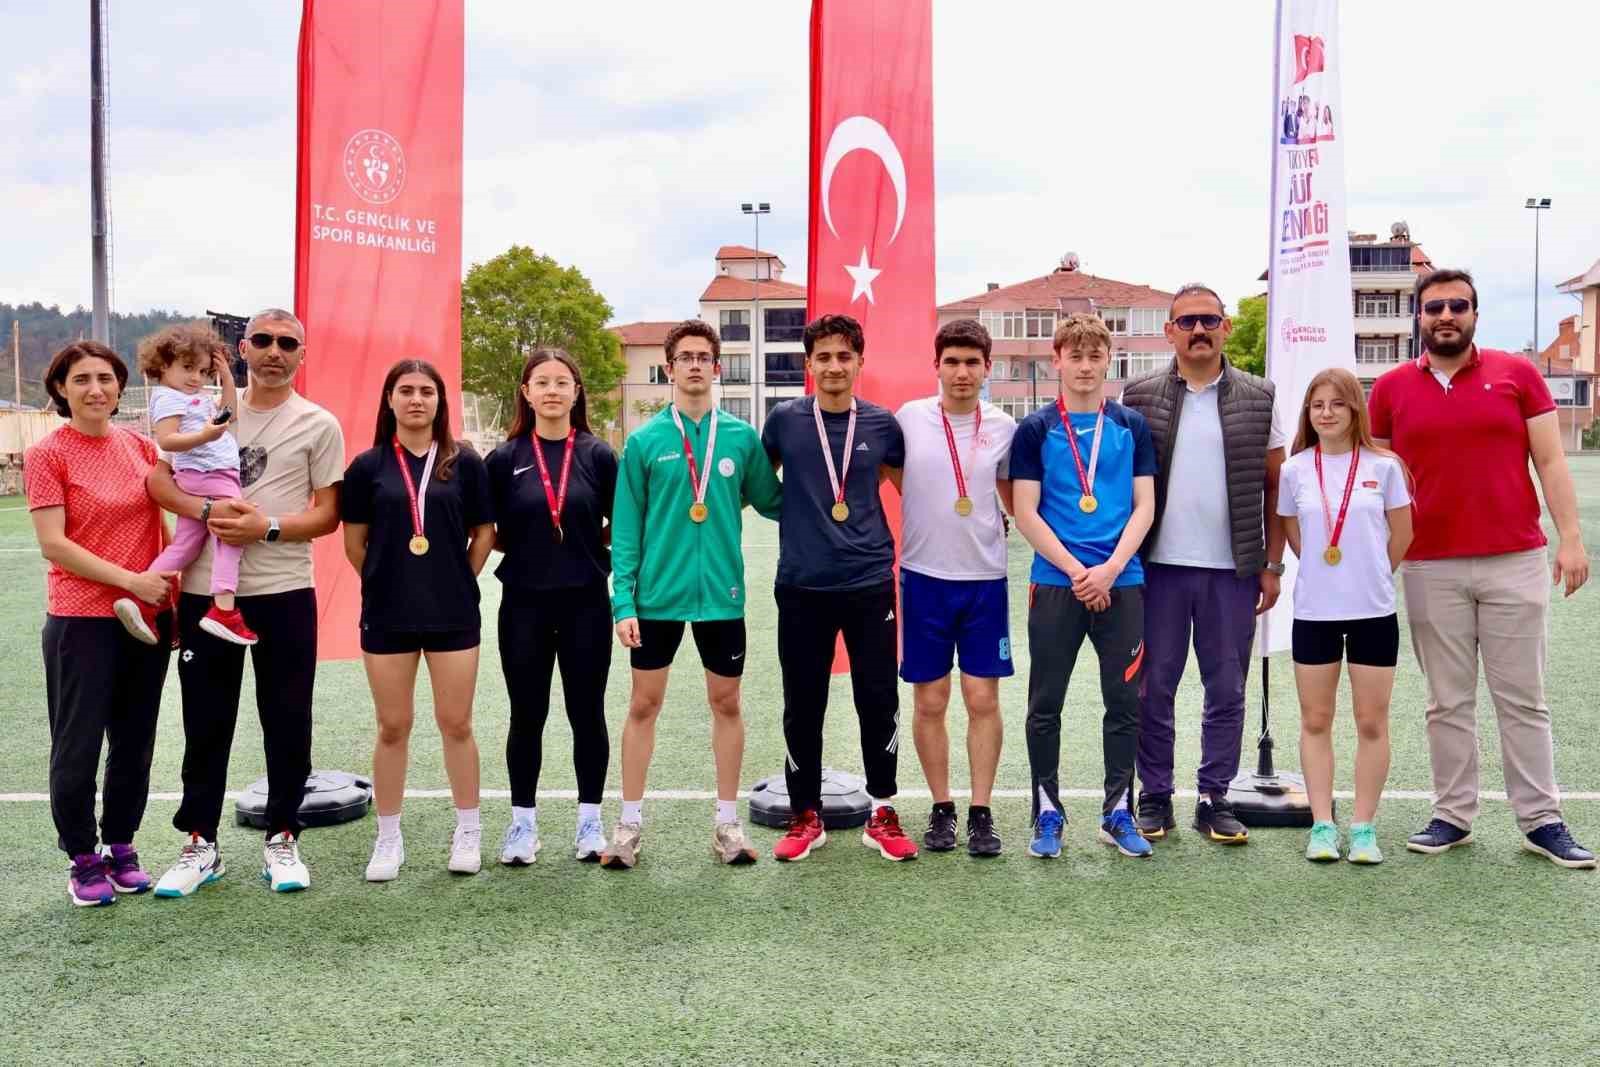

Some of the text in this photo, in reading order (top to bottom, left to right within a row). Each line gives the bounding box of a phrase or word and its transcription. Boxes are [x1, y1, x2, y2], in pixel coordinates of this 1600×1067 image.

[313, 203, 340, 222] T.C.
[416, 218, 437, 234] VE
[312, 224, 436, 254] SPOR BAKANLIĞI
[999, 636, 1009, 660] 8
